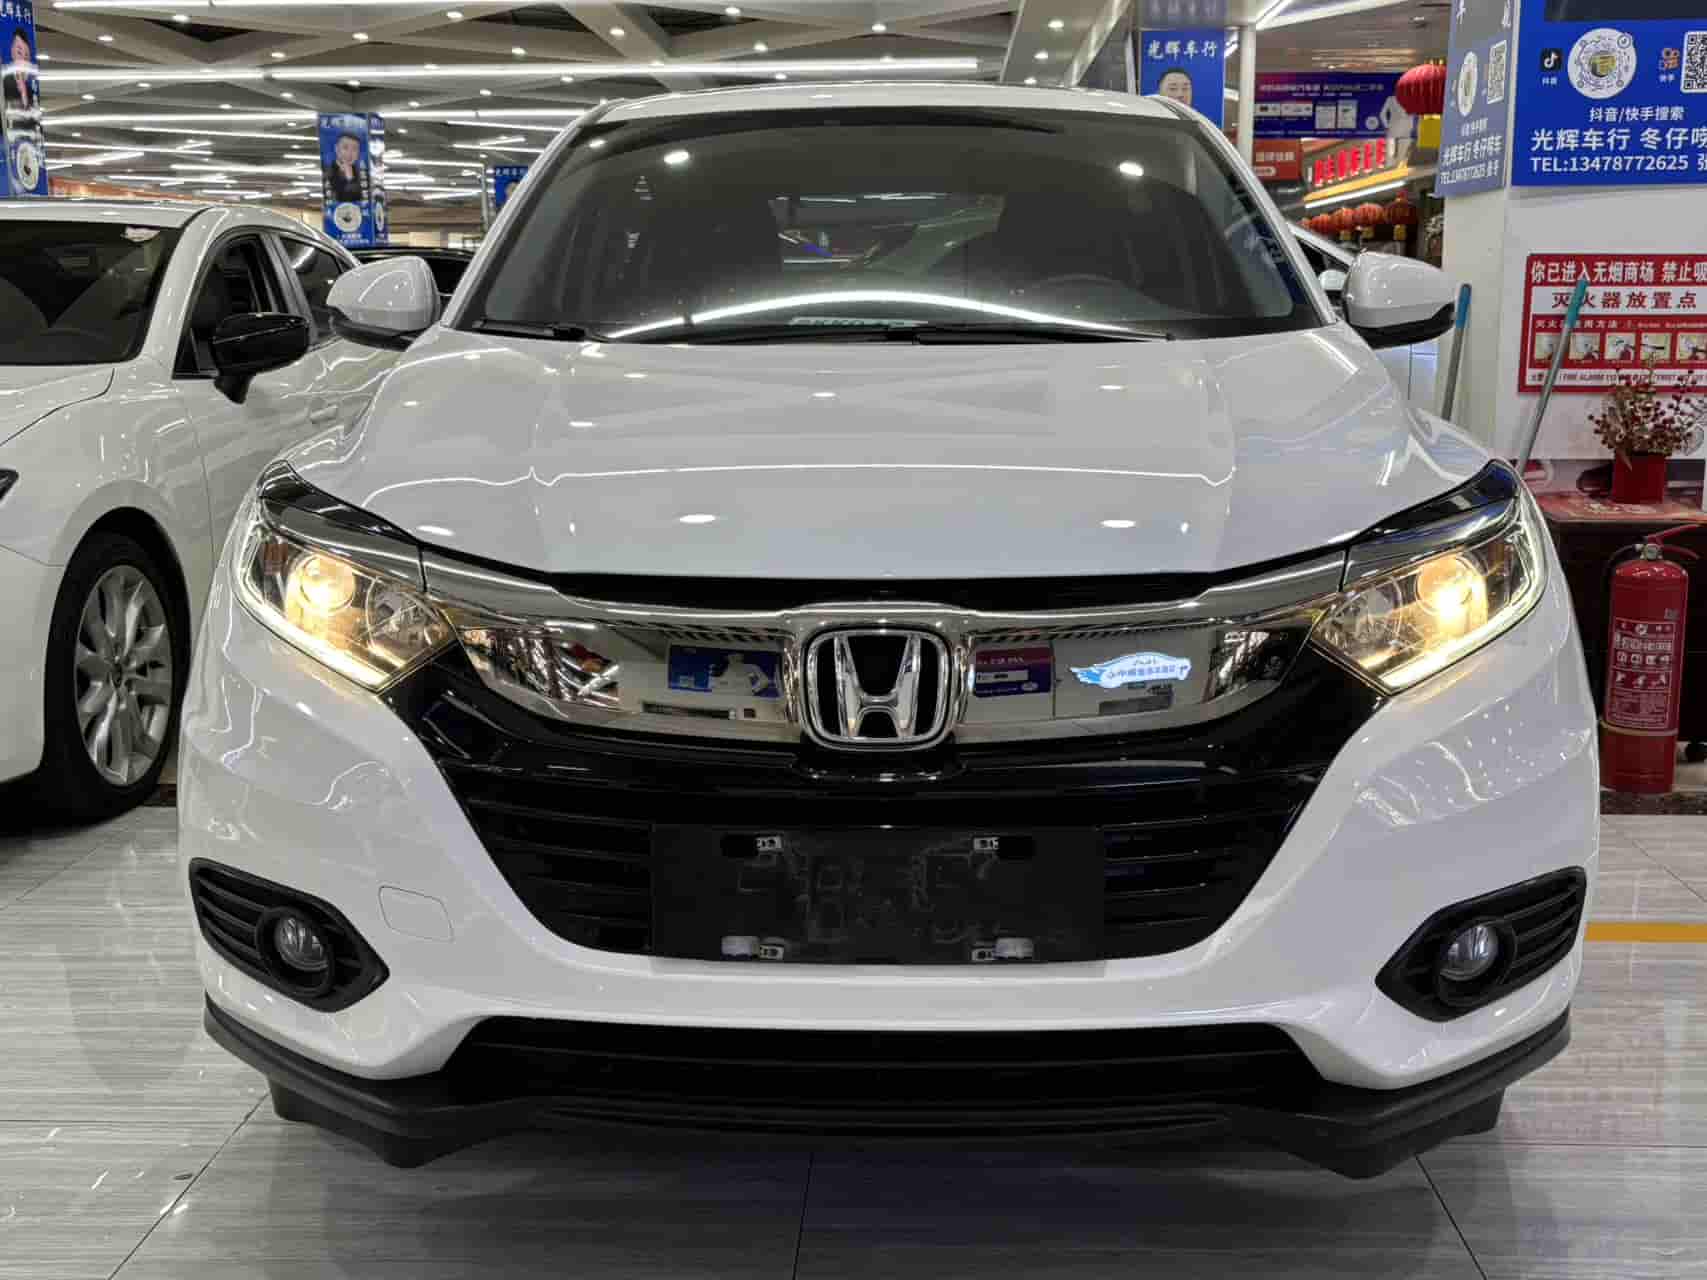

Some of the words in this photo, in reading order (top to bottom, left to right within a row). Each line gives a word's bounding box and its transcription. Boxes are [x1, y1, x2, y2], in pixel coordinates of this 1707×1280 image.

[1589, 106, 1685, 123] 抖音/快手搜索
[1531, 128, 1631, 151] 光辉车行
[1530, 156, 1689, 173] TEL:13478772625
[1531, 261, 1655, 284] 你已进入无烟商场
